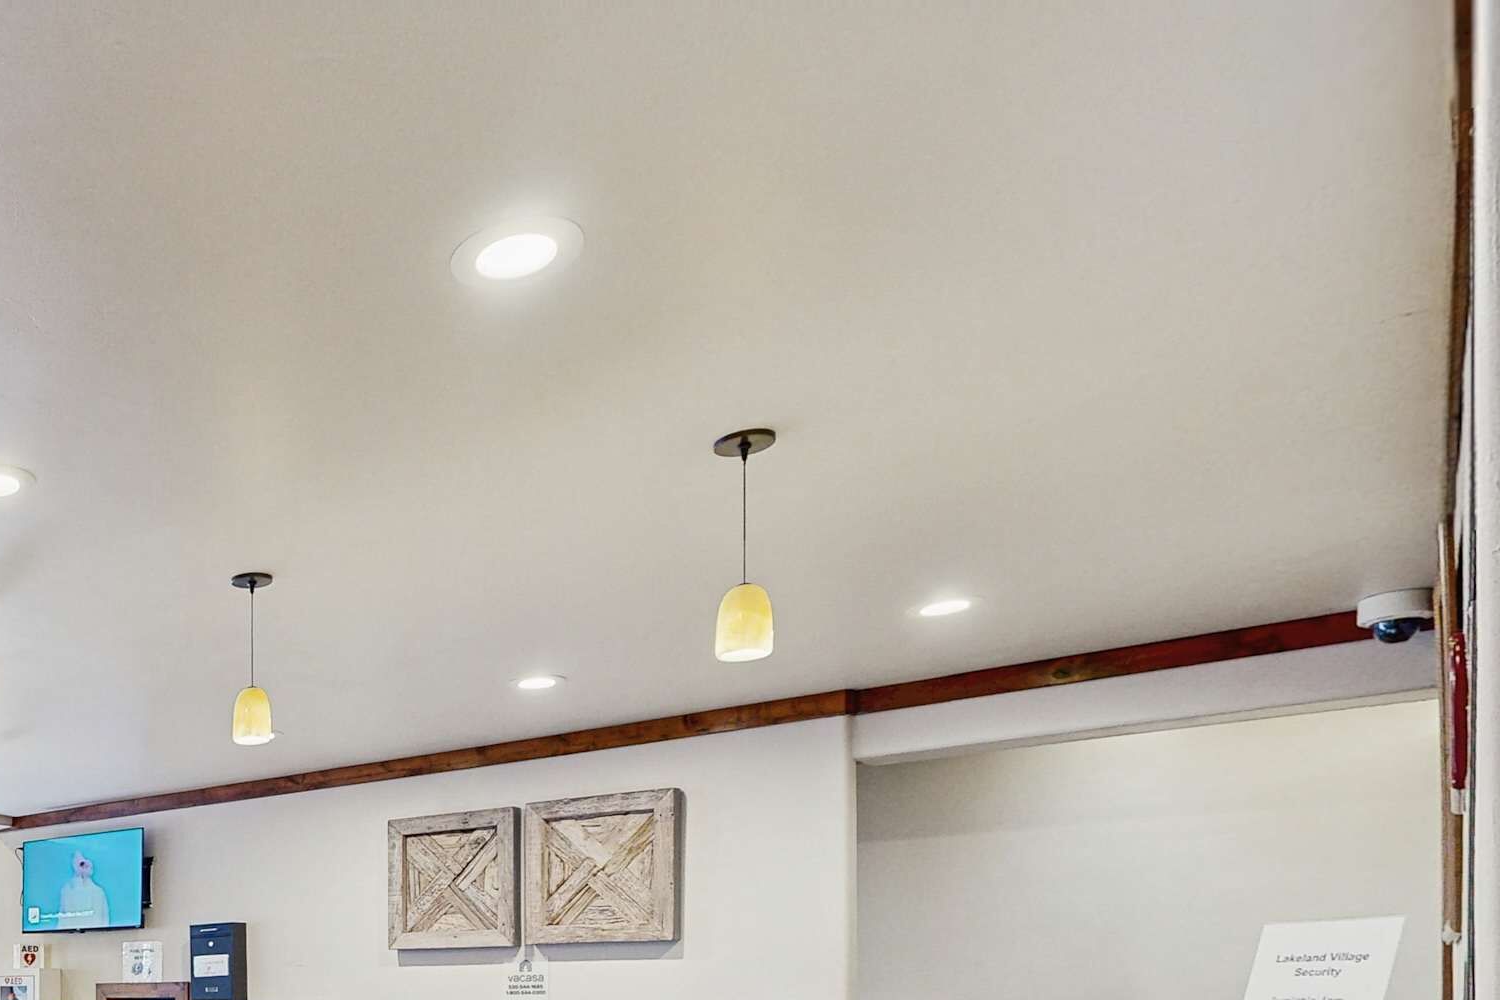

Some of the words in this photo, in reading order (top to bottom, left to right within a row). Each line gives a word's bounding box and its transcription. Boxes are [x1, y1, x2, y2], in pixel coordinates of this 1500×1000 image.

[21, 945, 39, 953] AED
[1275, 953, 1327, 964] Lakeland
[1330, 952, 1370, 964] Village
[1294, 967, 1343, 978] Security
[508, 974, 545, 983] vacasa
